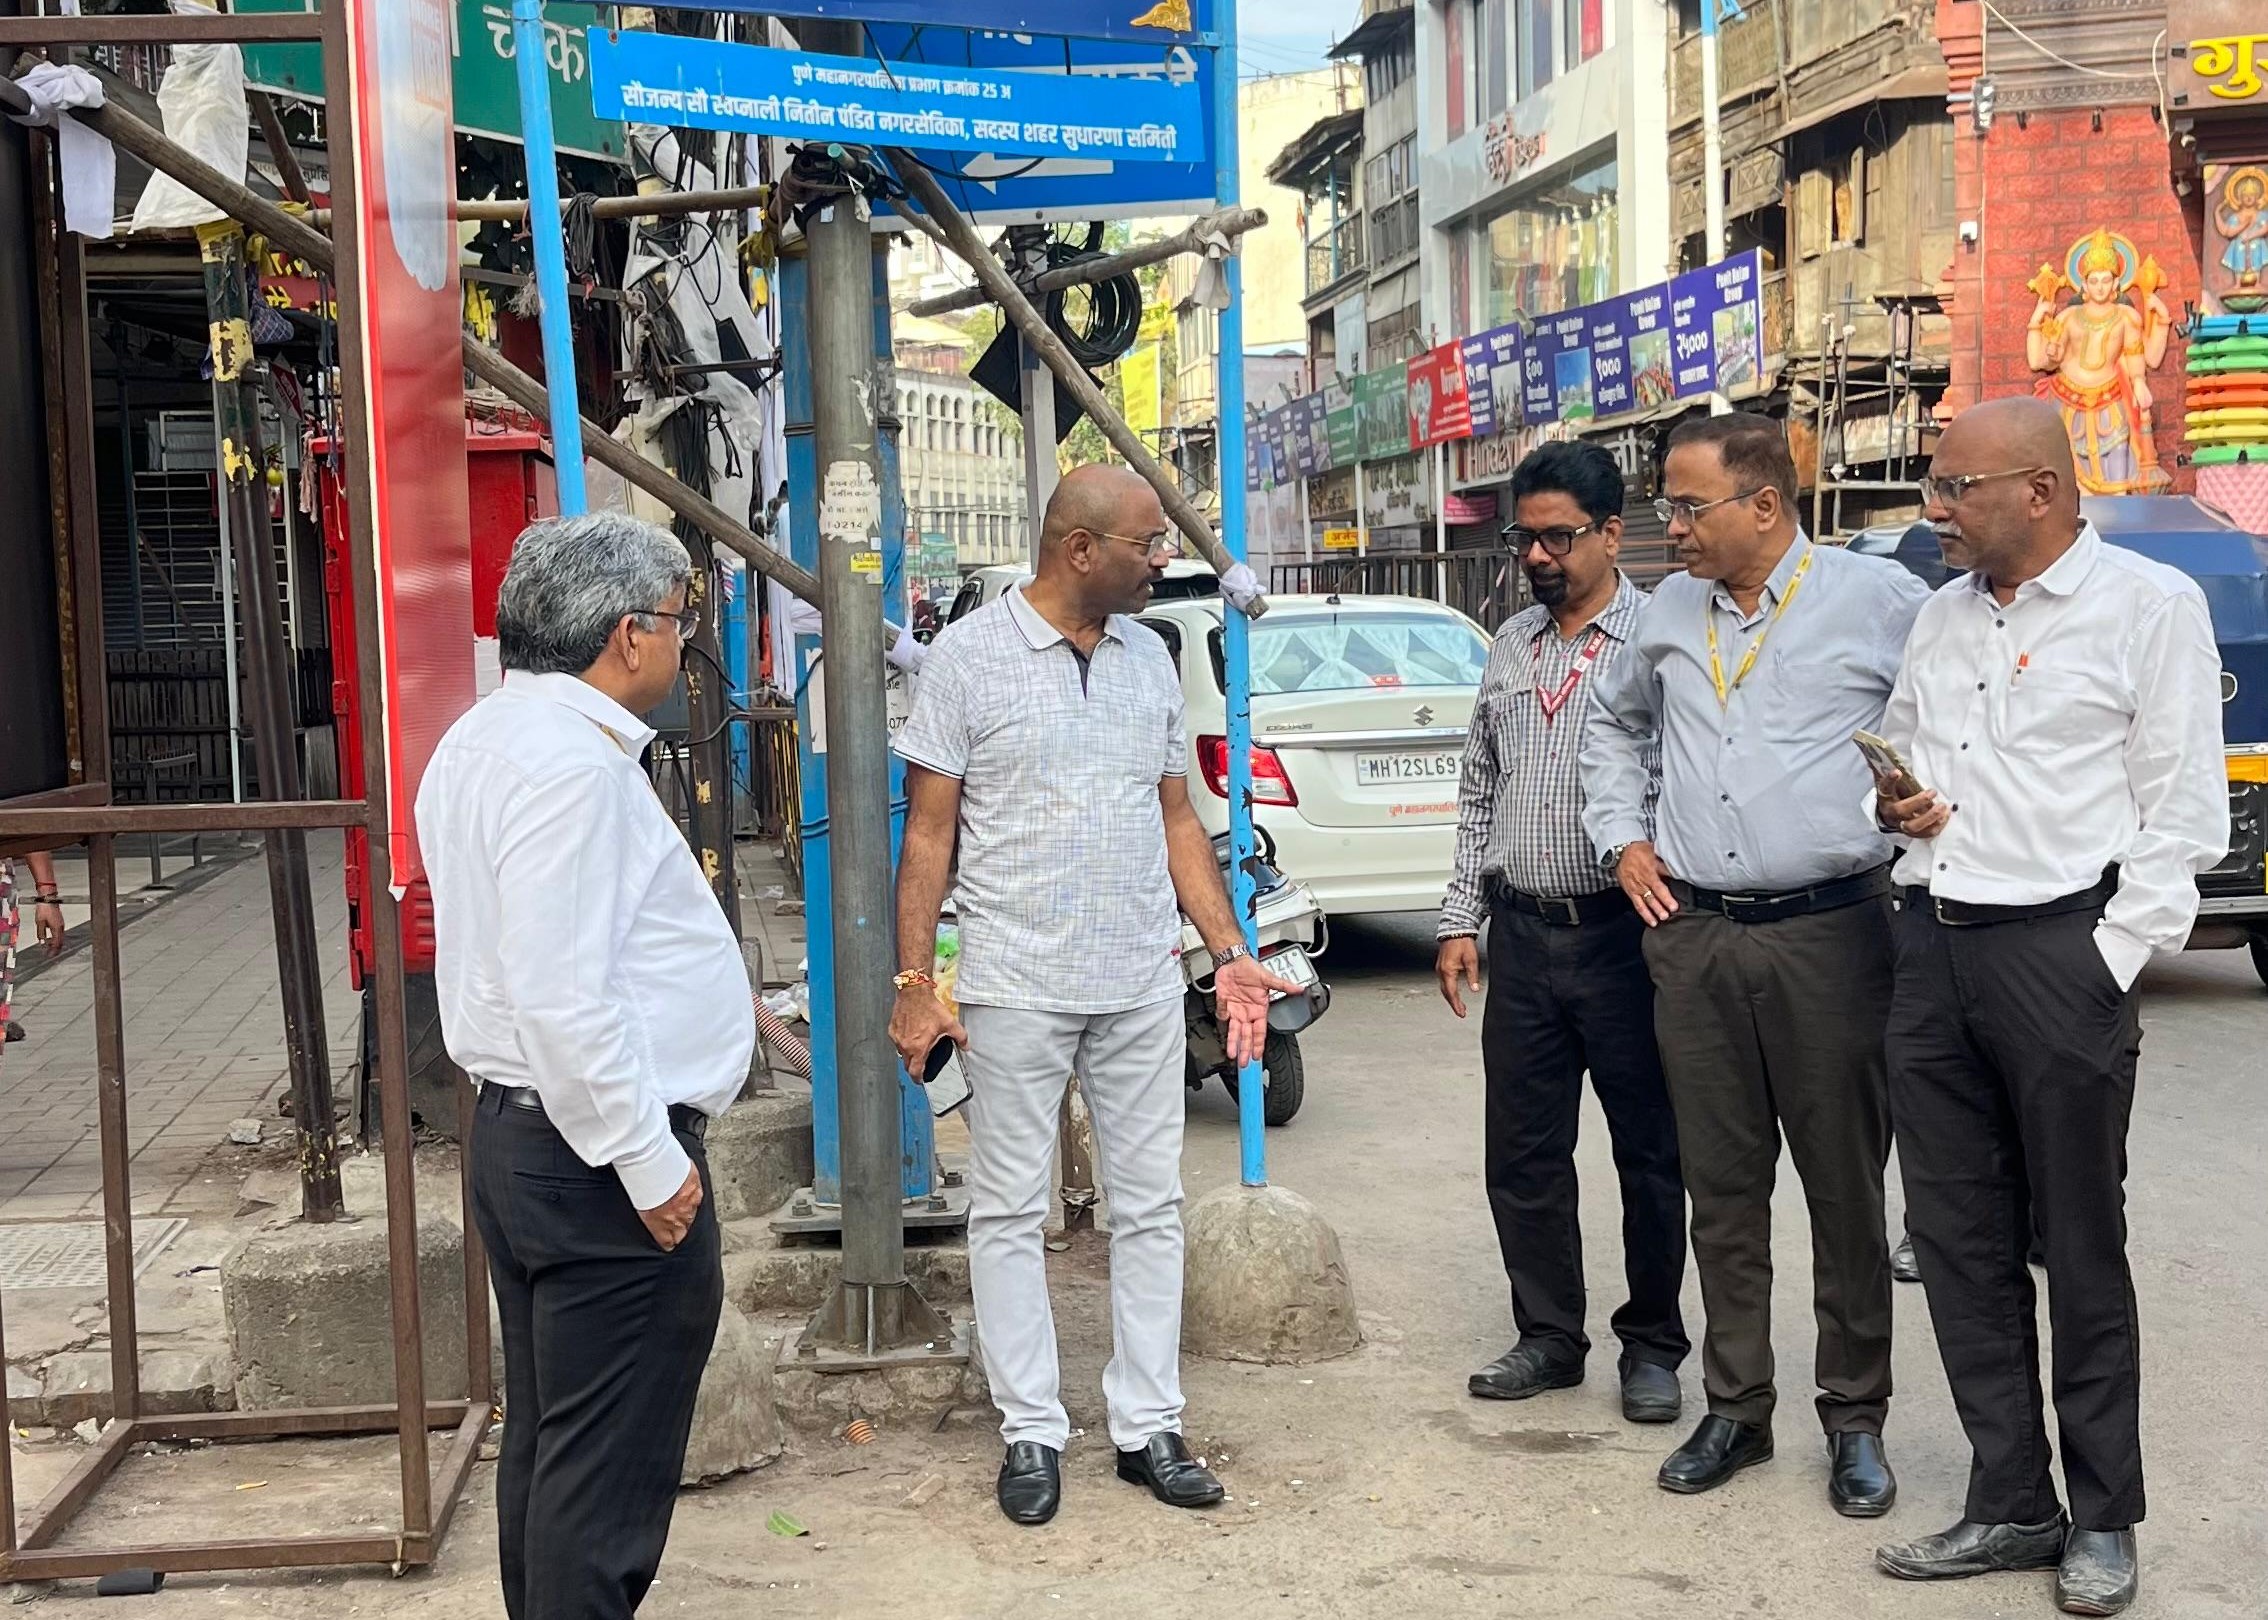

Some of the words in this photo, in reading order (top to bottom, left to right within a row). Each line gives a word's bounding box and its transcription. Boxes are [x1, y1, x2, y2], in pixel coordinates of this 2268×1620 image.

[482, 0, 586, 84] चक
[2189, 32, 2268, 99] गु
[792, 62, 813, 86] पुणे
[907, 75, 942, 95] प्रभाग
[943, 78, 980, 97] क्रमांक
[982, 82, 997, 99] 25
[1000, 84, 1012, 100] अ
[620, 80, 683, 111] सौजन्य
[686, 87, 708, 114] सौ
[712, 94, 781, 122] स्वप्नाली
[783, 98, 835, 127] नितीन
[838, 102, 875, 131] पंडित
[878, 109, 970, 141] नगरसेविका,
[972, 118, 1020, 141] सदस्य
[1023, 122, 1058, 144] शहर
[1060, 124, 1123, 151] सुधारणा
[1127, 124, 1176, 149] समिती
[1369, 756, 1463, 779] MH12SL69
